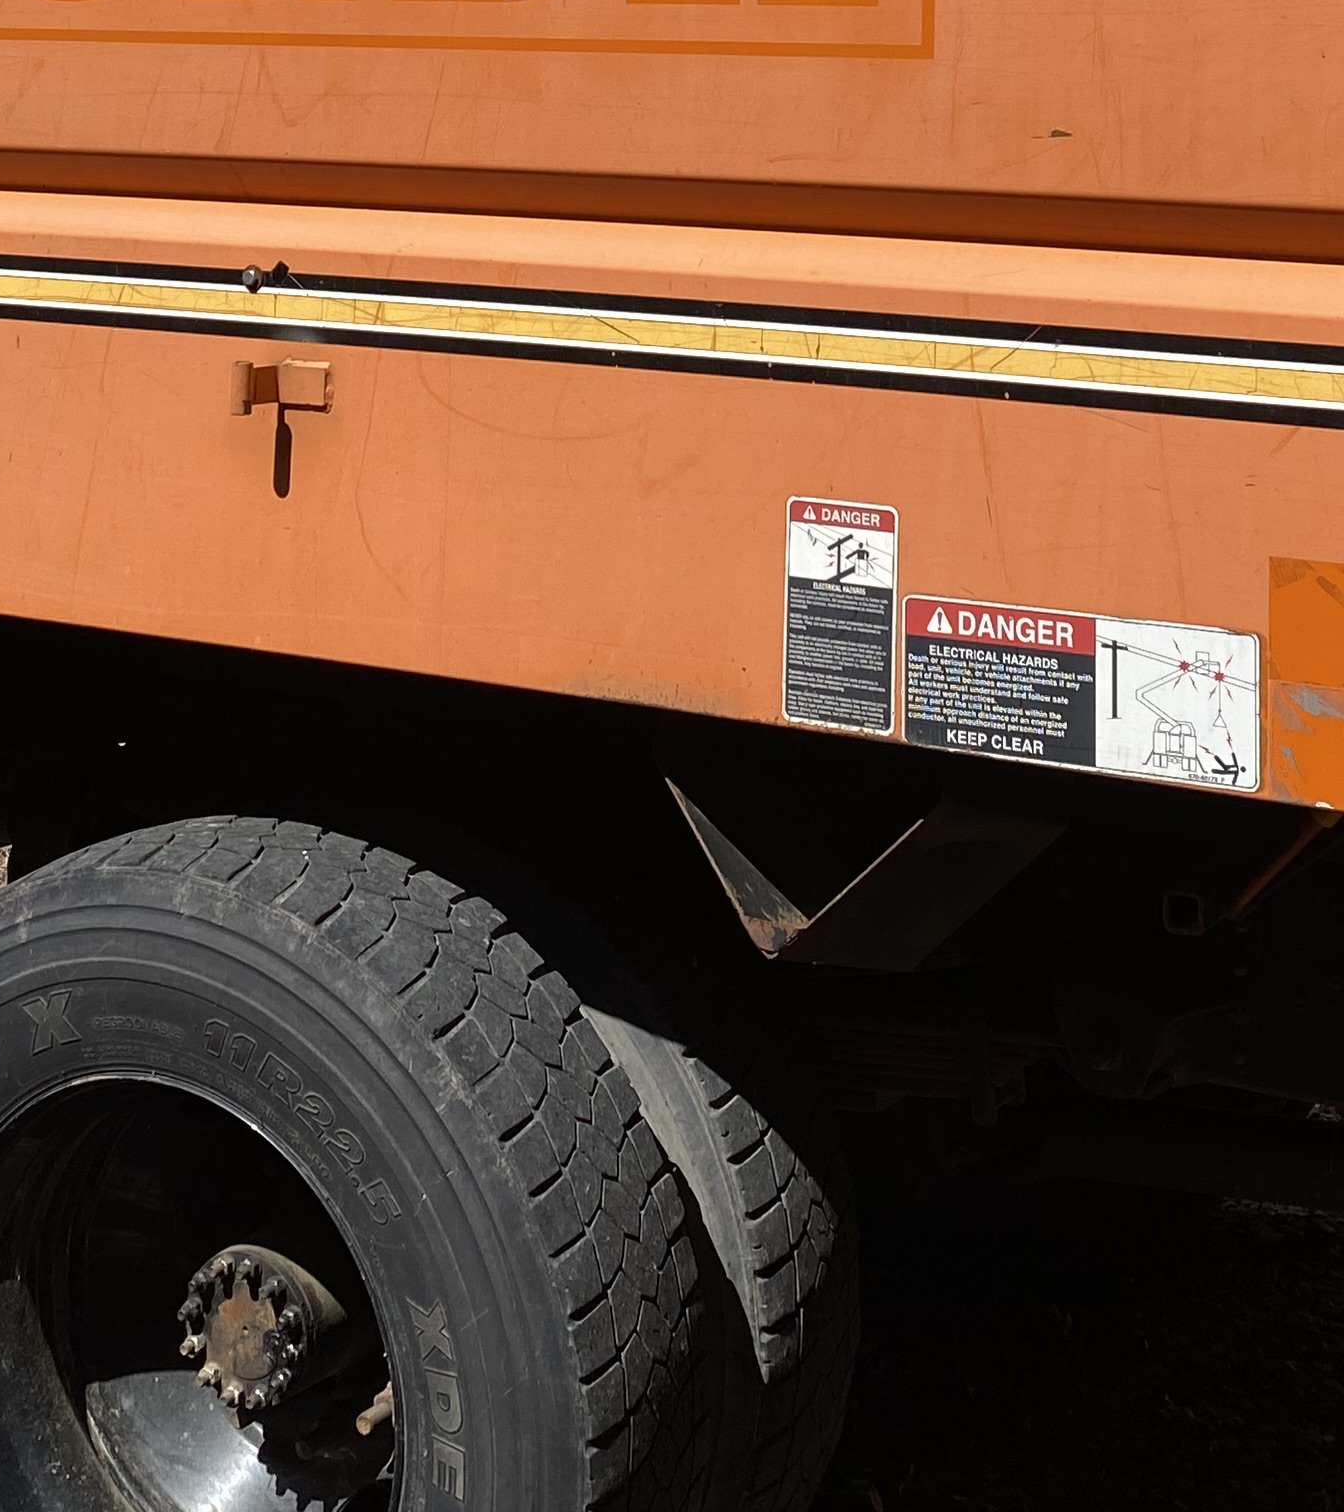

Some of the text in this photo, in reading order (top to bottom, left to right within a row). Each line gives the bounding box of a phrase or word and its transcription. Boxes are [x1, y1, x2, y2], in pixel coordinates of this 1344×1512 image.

[821, 508, 880, 527] DANGER
[958, 610, 1074, 648] DANGER
[929, 644, 1058, 669] ELECTRICAL HAZARDS
[947, 729, 1044, 755] KEEP CLEAR
[19, 990, 82, 1055] X
